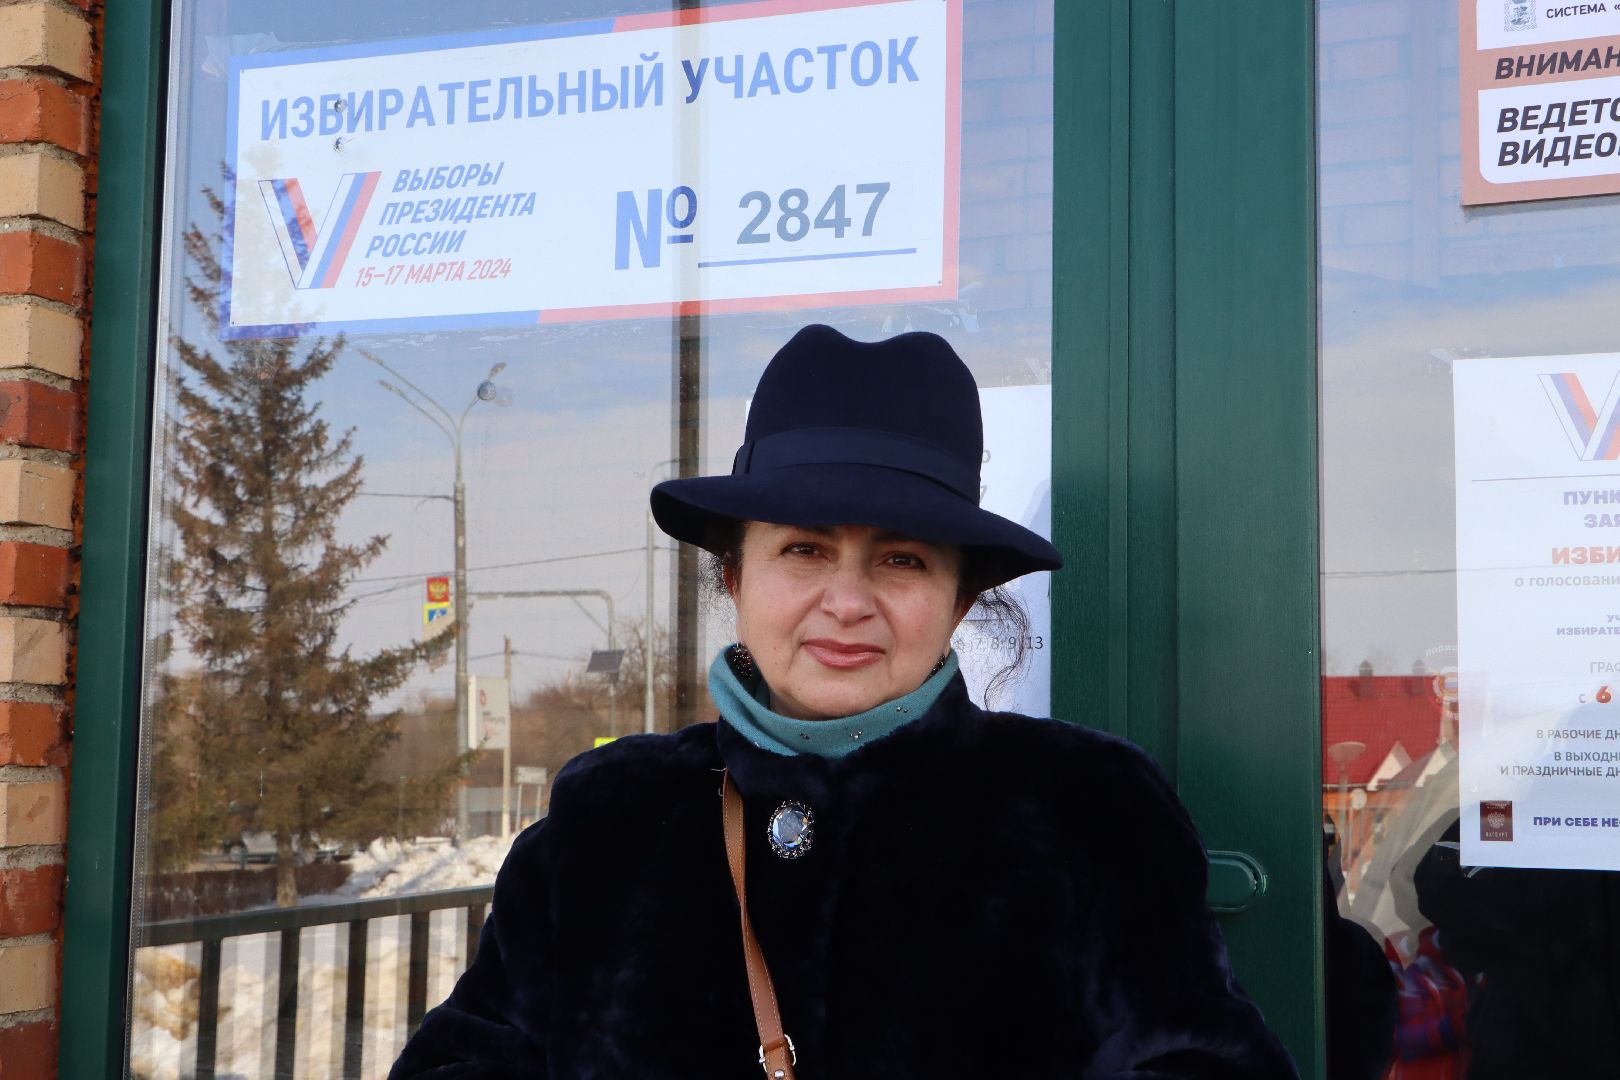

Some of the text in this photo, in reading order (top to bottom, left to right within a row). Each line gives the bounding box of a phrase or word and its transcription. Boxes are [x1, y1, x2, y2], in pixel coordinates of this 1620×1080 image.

[1546, 2, 1607, 19] СИСТЕМА
[260, 35, 920, 141] ИЗБИРАТЕЛЬНЫЙ УЧАСТОК
[1498, 132, 1620, 168] ВИДЕО
[392, 161, 505, 193] ВЫБОРЫ
[378, 191, 537, 226] ПРЕЗИДЕНТА
[614, 182, 891, 270] № 2847
[364, 229, 467, 258] РОССИИ
[404, 260, 466, 284] МАРТА
[467, 257, 512, 281] 2024
[1595, 685, 1612, 704] 6
[1536, 729, 1544, 739] В
[1547, 729, 1602, 739] РАБОЧИЕ
[1554, 751, 1562, 761] В
[1500, 766, 1508, 776] И
[1512, 765, 1603, 777] ПРАЗДНИЧНЫЕ
[1533, 816, 1620, 828] ПРИ СЕБЕ НЕ
